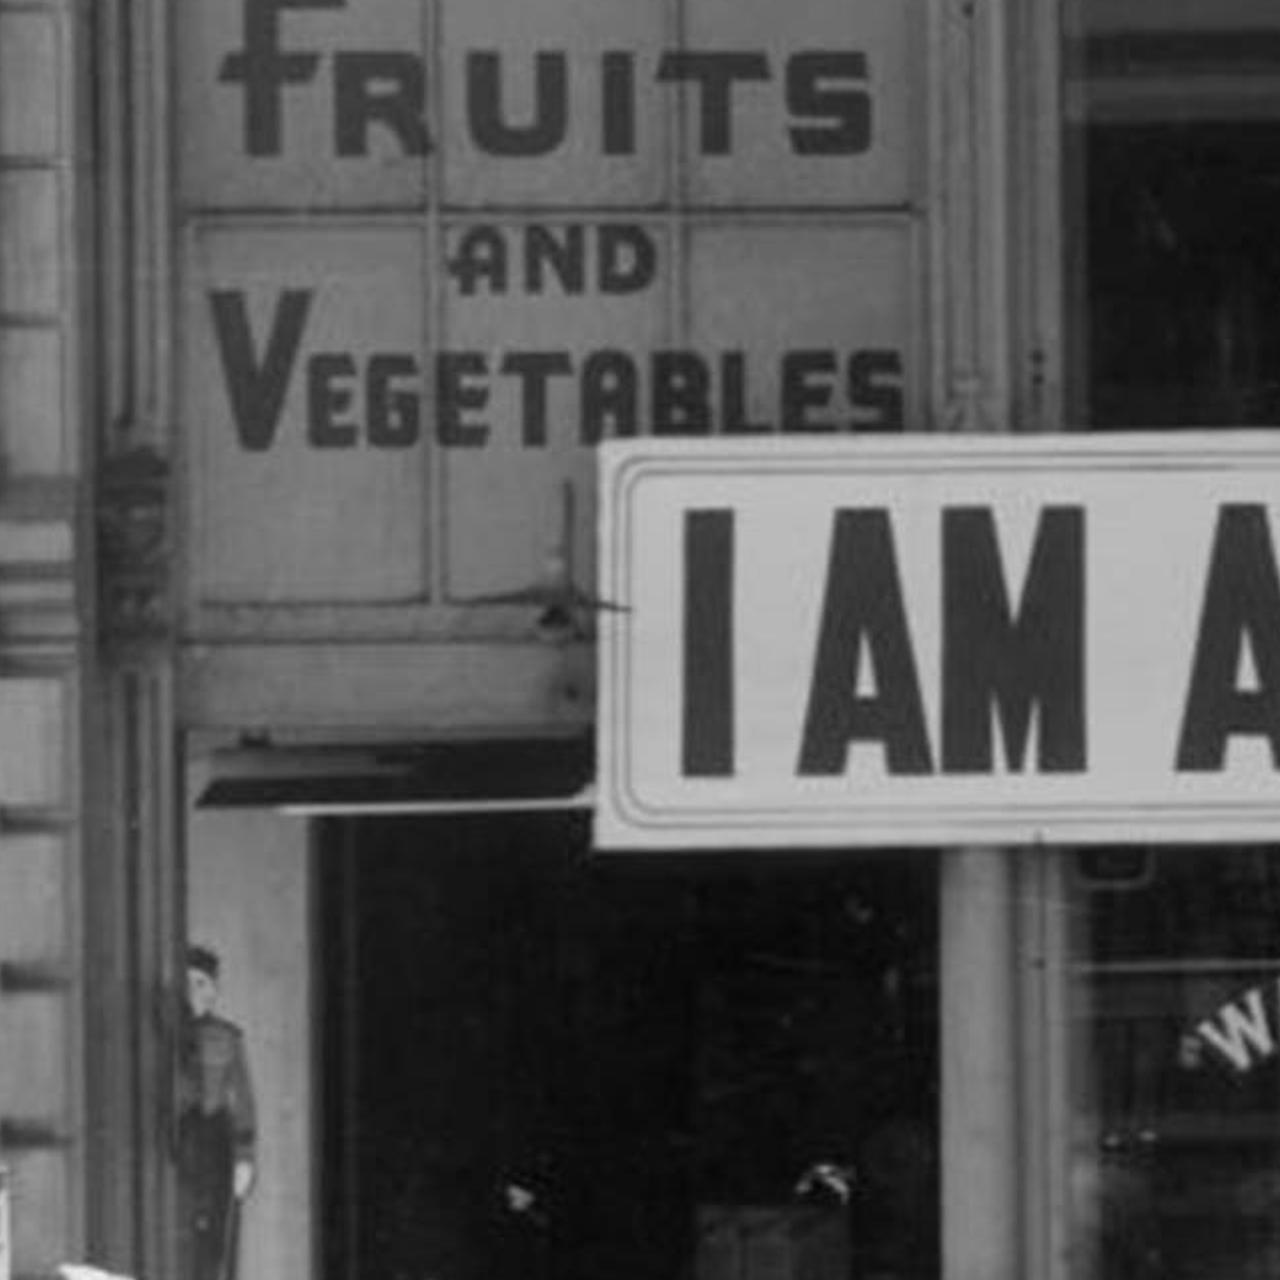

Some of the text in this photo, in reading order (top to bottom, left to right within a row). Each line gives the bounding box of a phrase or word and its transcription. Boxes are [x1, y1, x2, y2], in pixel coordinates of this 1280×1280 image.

[447, 223, 659, 296] AND
[208, 288, 906, 452] VEGETABLES
[682, 509, 734, 777] I
[797, 506, 1087, 776] AM
